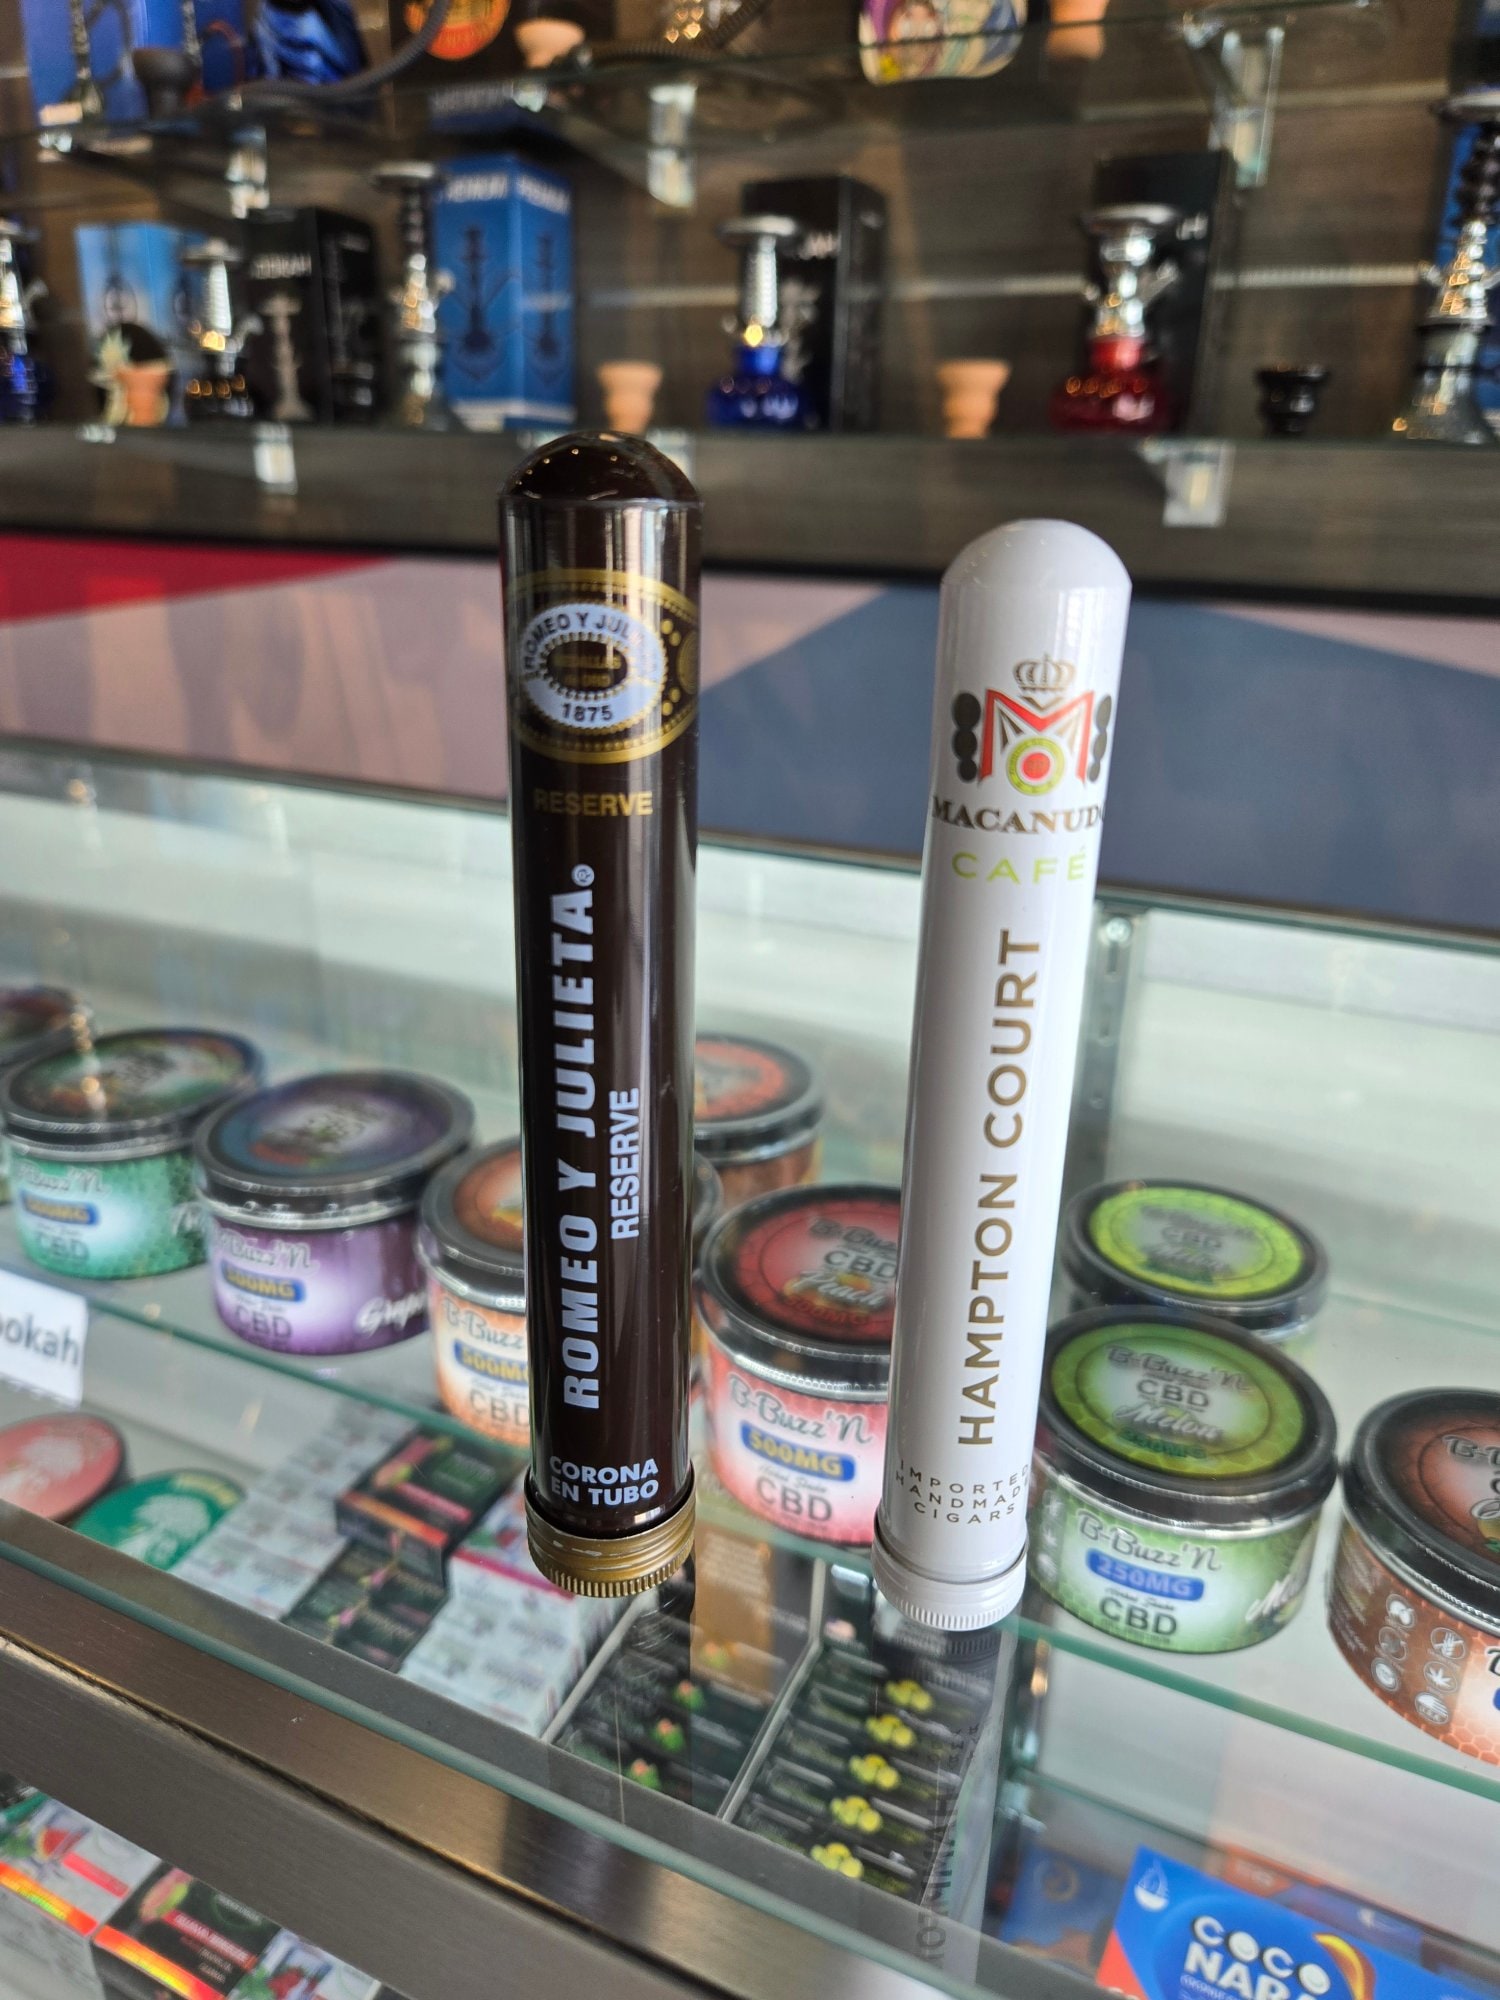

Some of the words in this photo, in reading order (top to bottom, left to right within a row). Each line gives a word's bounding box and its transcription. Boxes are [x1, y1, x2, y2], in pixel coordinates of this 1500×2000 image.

[562, 703, 614, 723] 1875
[533, 788, 654, 817] RESERVE
[931, 796, 1104, 835] MACANUD
[951, 846, 1087, 885] CAFÉ
[984, 928, 1040, 1149] COURT
[557, 1158, 597, 1192] Y
[609, 1087, 641, 1240] RESERVE
[823, 1250, 897, 1280] CBD
[236, 1304, 293, 1339] CBD
[559, 1214, 600, 1409] ROMEO
[958, 1173, 1018, 1446] HAMPTON
[1136, 1377, 1211, 1410] CBD
[549, 1455, 659, 1486] CORONA
[749, 1430, 843, 1477] 500MG
[551, 1475, 580, 1502] EN
[587, 1479, 660, 1506] TUBO
[899, 1458, 1029, 1495] IMPORTED
[755, 1475, 833, 1523] CBD
[913, 1501, 1016, 1525] CIGARS
[1098, 1556, 1194, 1598] 250MG
[1100, 1596, 1178, 1636] CBD
[1183, 1942, 1318, 2000] NAR
[1191, 1915, 1331, 1996] COCO
